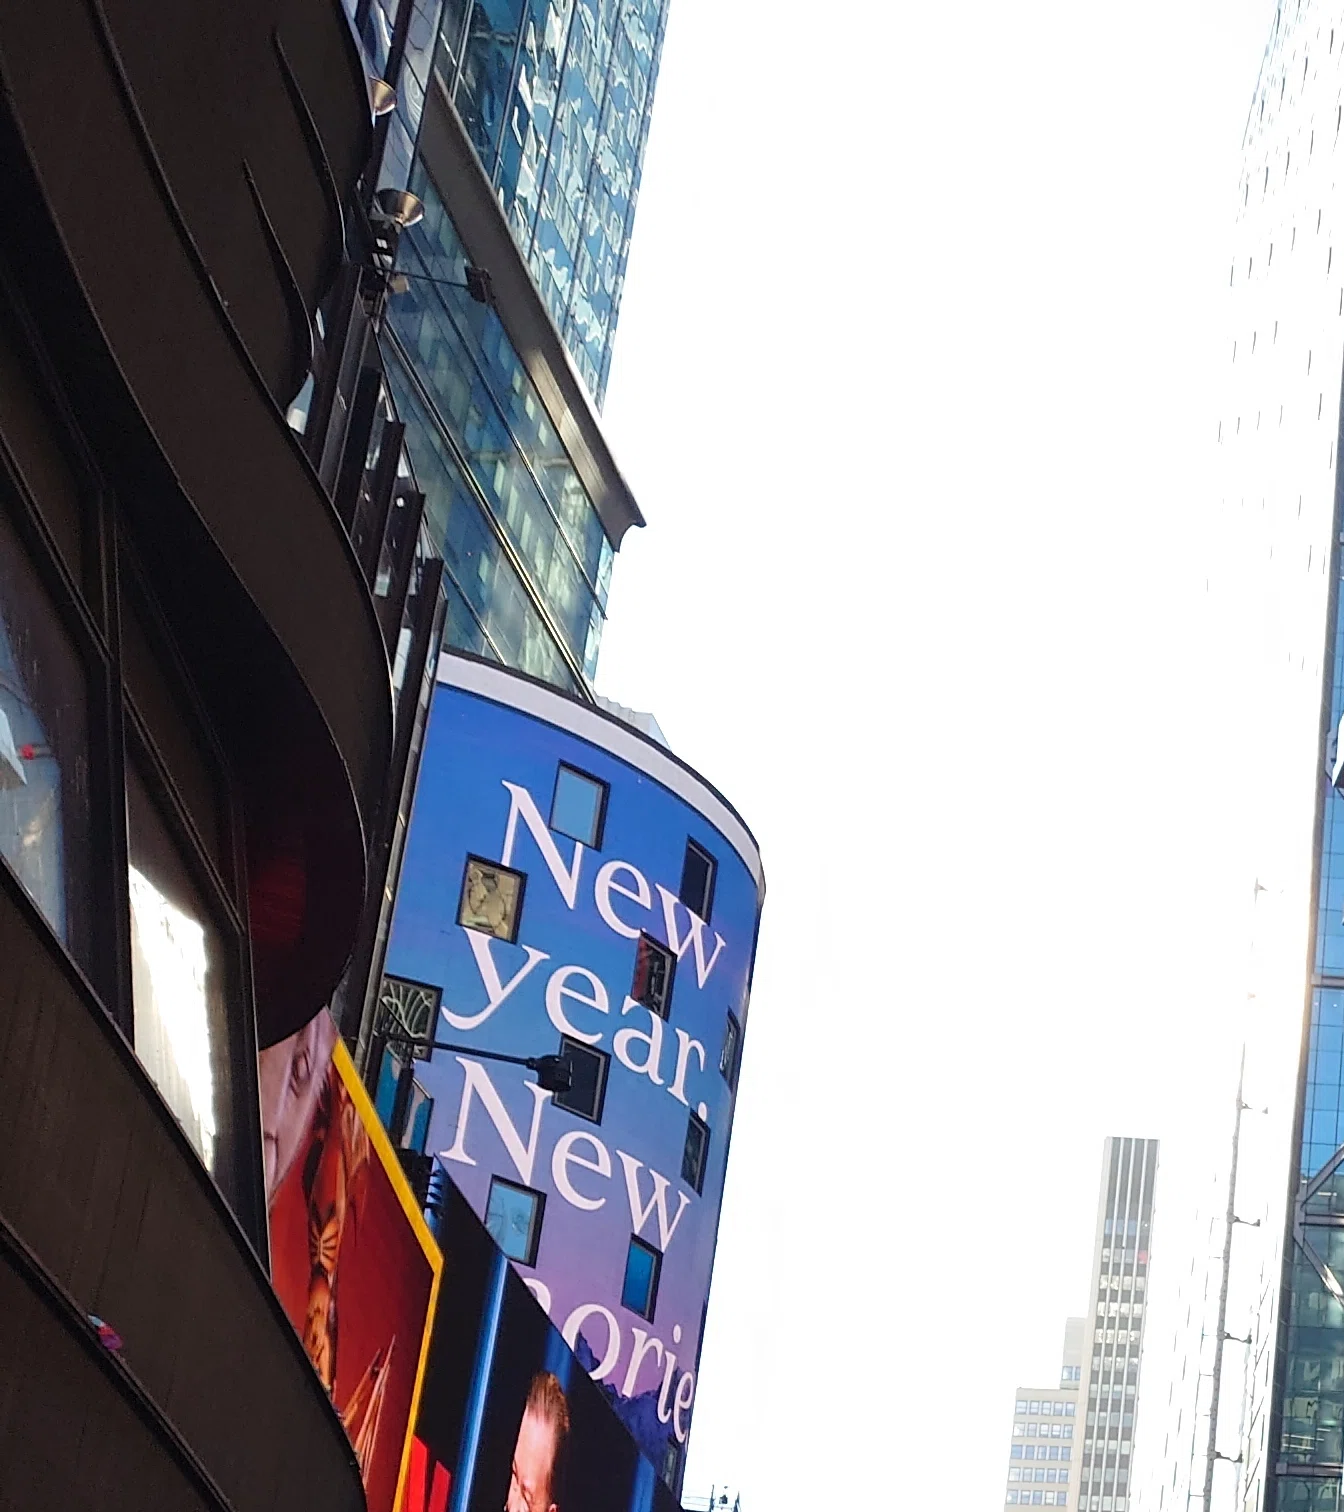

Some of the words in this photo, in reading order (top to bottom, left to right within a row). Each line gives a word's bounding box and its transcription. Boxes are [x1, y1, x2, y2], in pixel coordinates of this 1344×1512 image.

[501, 780, 727, 990] New
[441, 930, 711, 1123] year.
[441, 1056, 694, 1254] New
